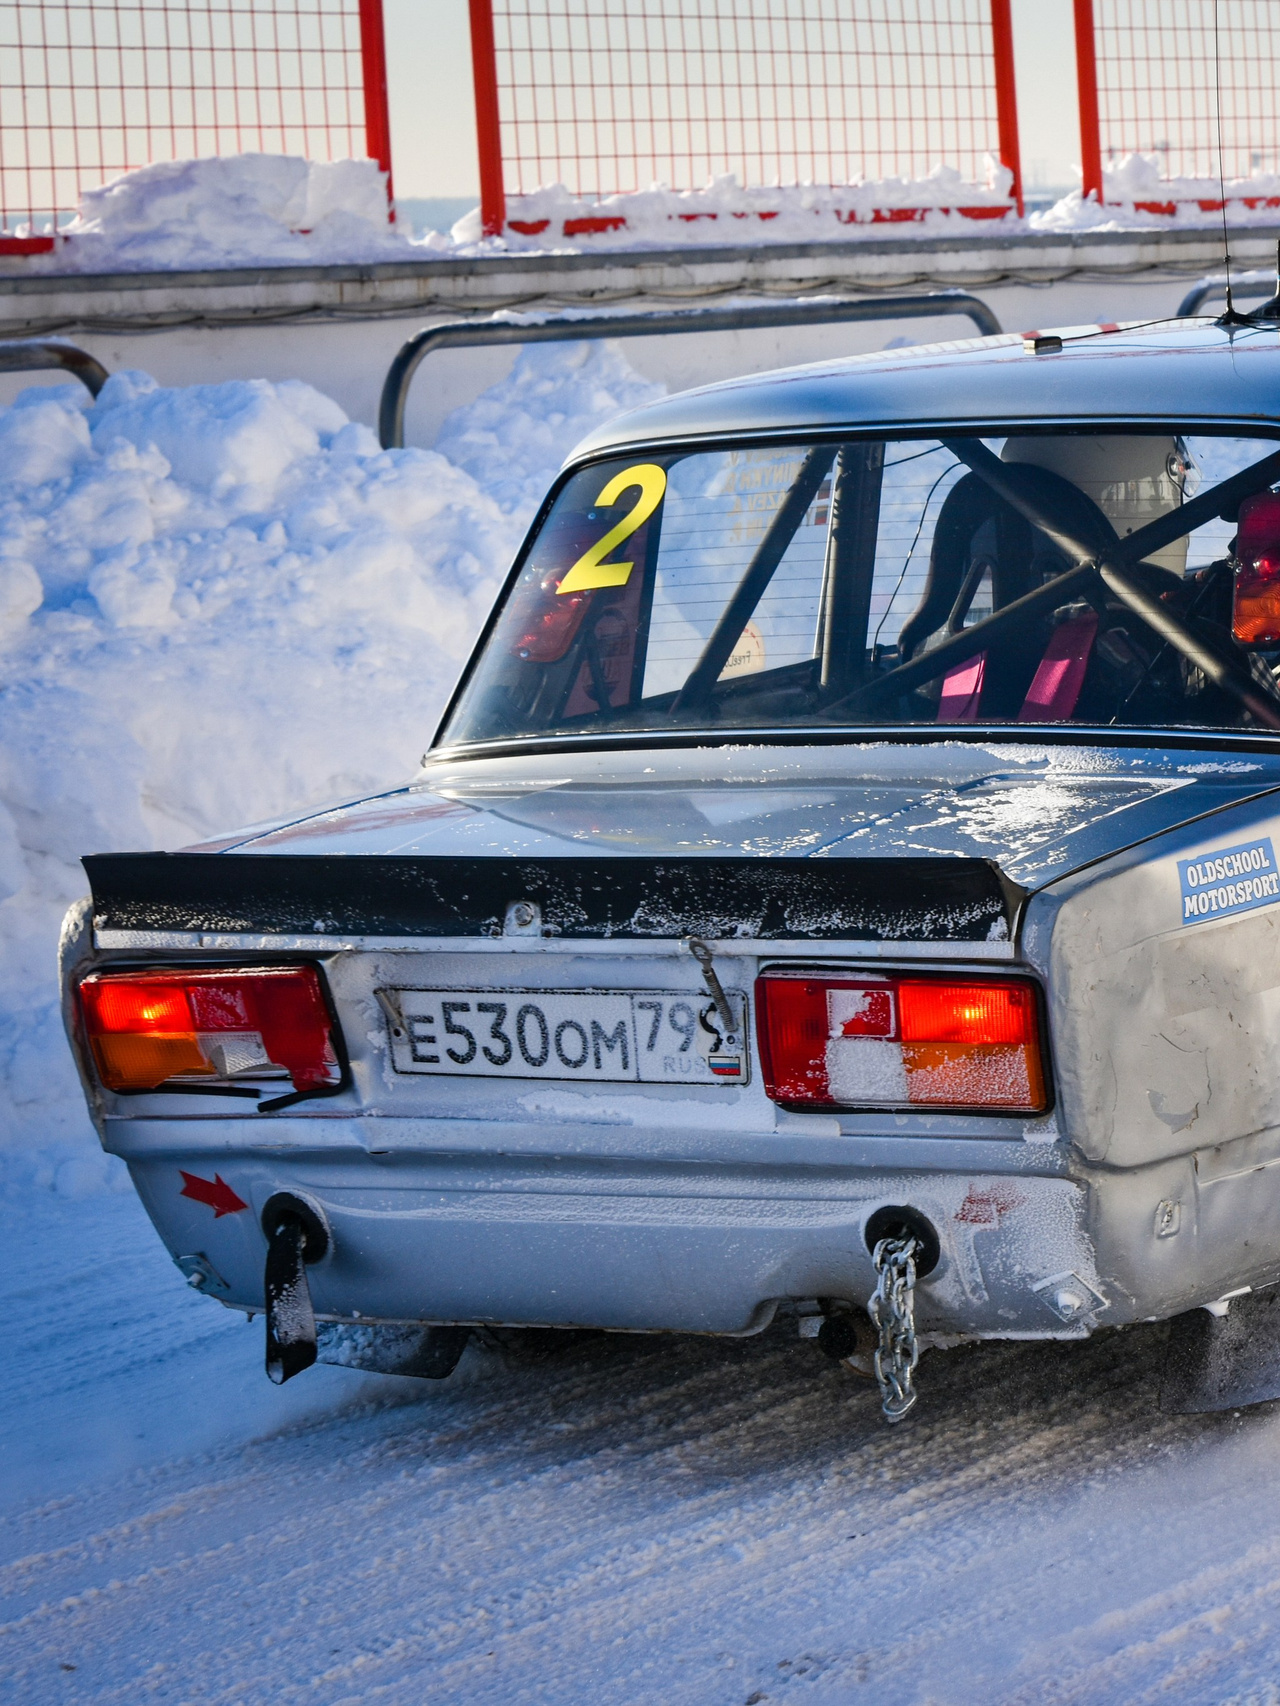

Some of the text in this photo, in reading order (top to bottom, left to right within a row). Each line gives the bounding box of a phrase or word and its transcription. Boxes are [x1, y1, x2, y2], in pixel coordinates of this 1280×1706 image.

[555, 463, 667, 595] 2
[1187, 847, 1270, 888] OLDSCHOOL
[1184, 872, 1280, 918] MOTORSPORT
